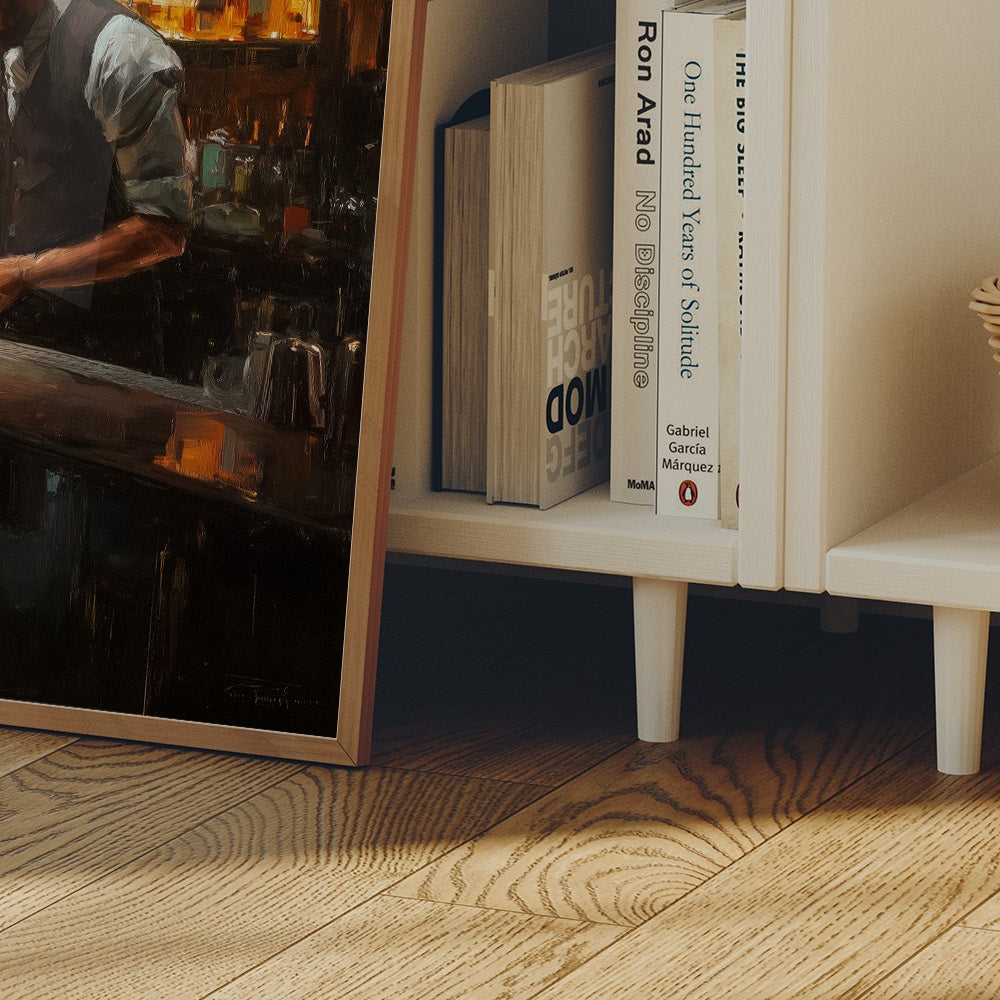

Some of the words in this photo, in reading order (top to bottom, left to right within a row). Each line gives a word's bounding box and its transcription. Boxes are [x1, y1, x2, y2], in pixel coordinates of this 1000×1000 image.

[637, 21, 657, 82] Ron
[683, 60, 702, 105] One
[635, 92, 657, 165] Arad
[682, 112, 702, 200] Hundred
[635, 190, 657, 232] No
[681, 207, 700, 261] Years
[681, 268, 700, 292] of
[630, 244, 656, 389] Discipline
[680, 298, 699, 379] Solitude
[666, 424, 710, 439] Gabriel
[668, 441, 706, 455] García
[627, 479, 655, 491] MoMA
[662, 458, 713, 474] Márquez
